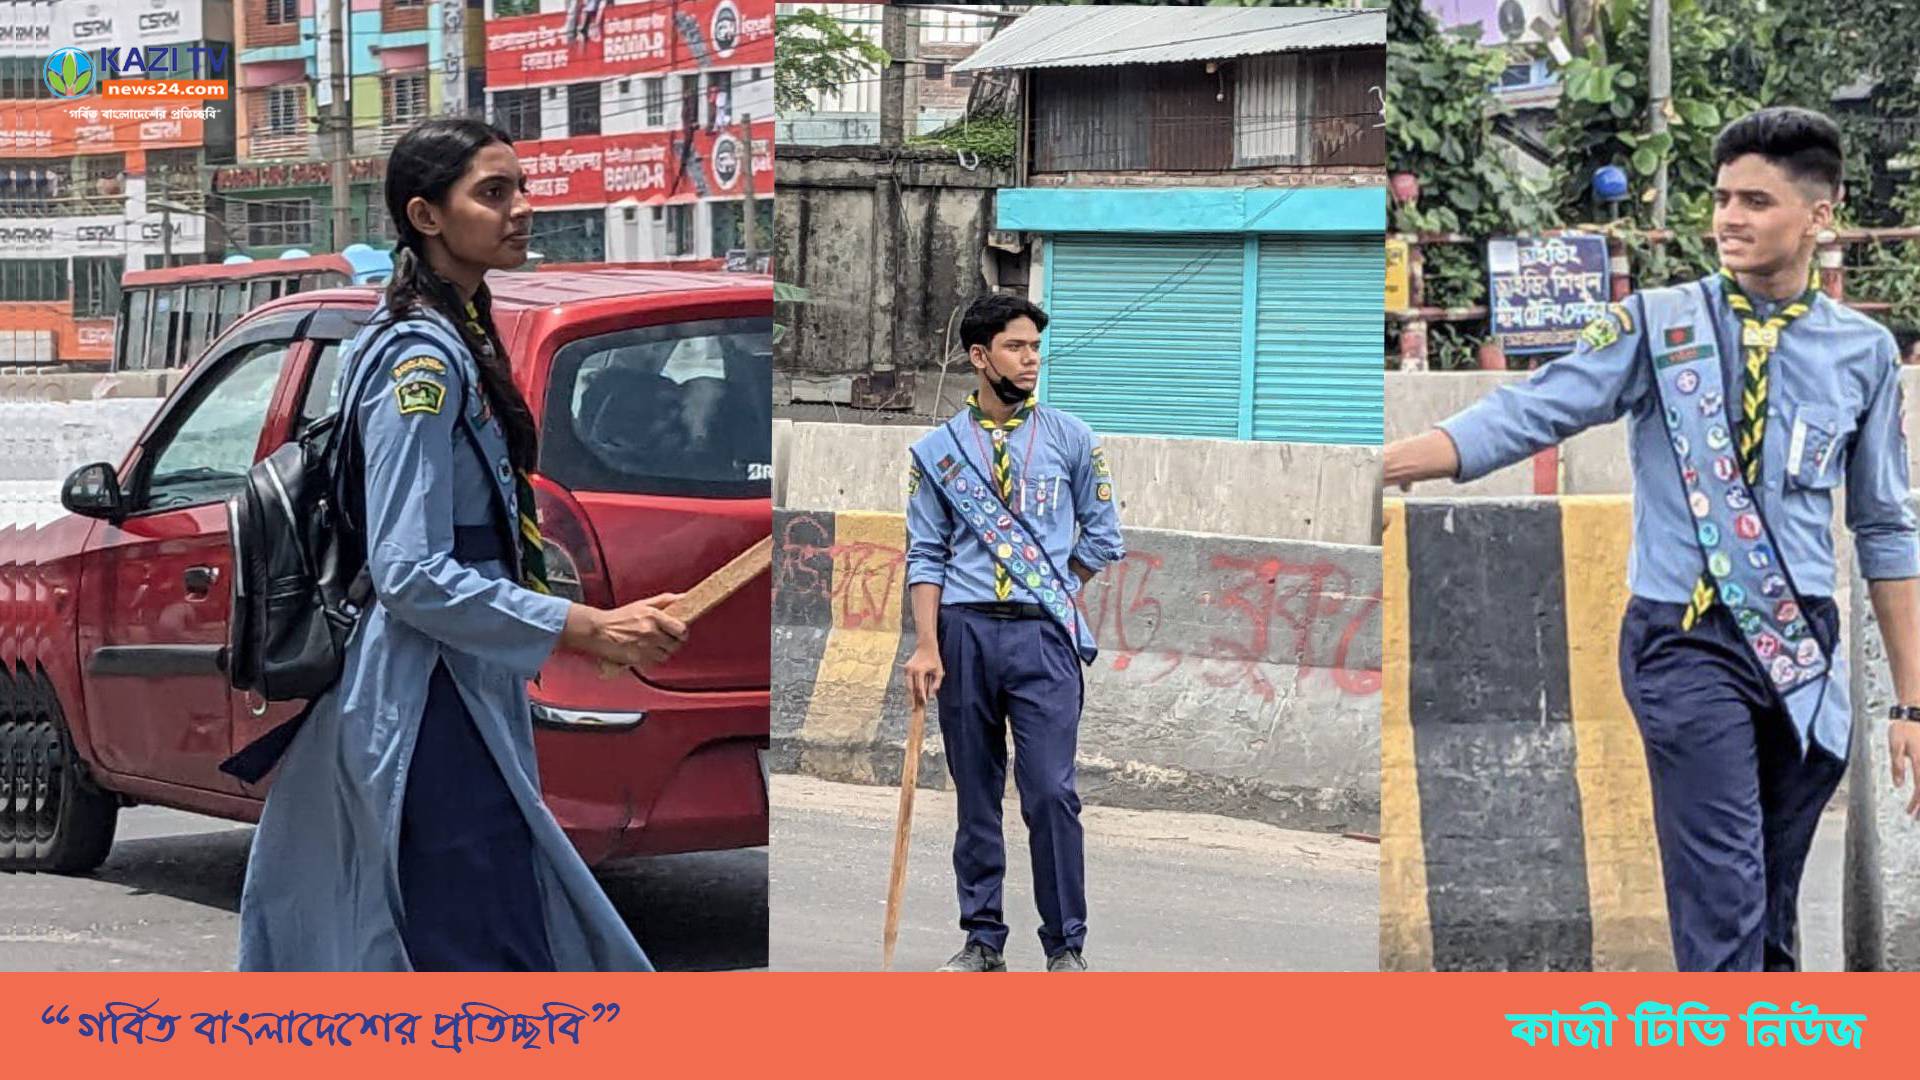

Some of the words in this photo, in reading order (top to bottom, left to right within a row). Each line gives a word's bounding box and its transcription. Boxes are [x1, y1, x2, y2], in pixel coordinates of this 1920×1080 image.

[73, 19, 112, 38] CSRM
[139, 11, 180, 31] CSRM
[139, 122, 182, 140] CSRM
[603, 163, 665, 192] B600D-R
[76, 225, 116, 241] CSRM
